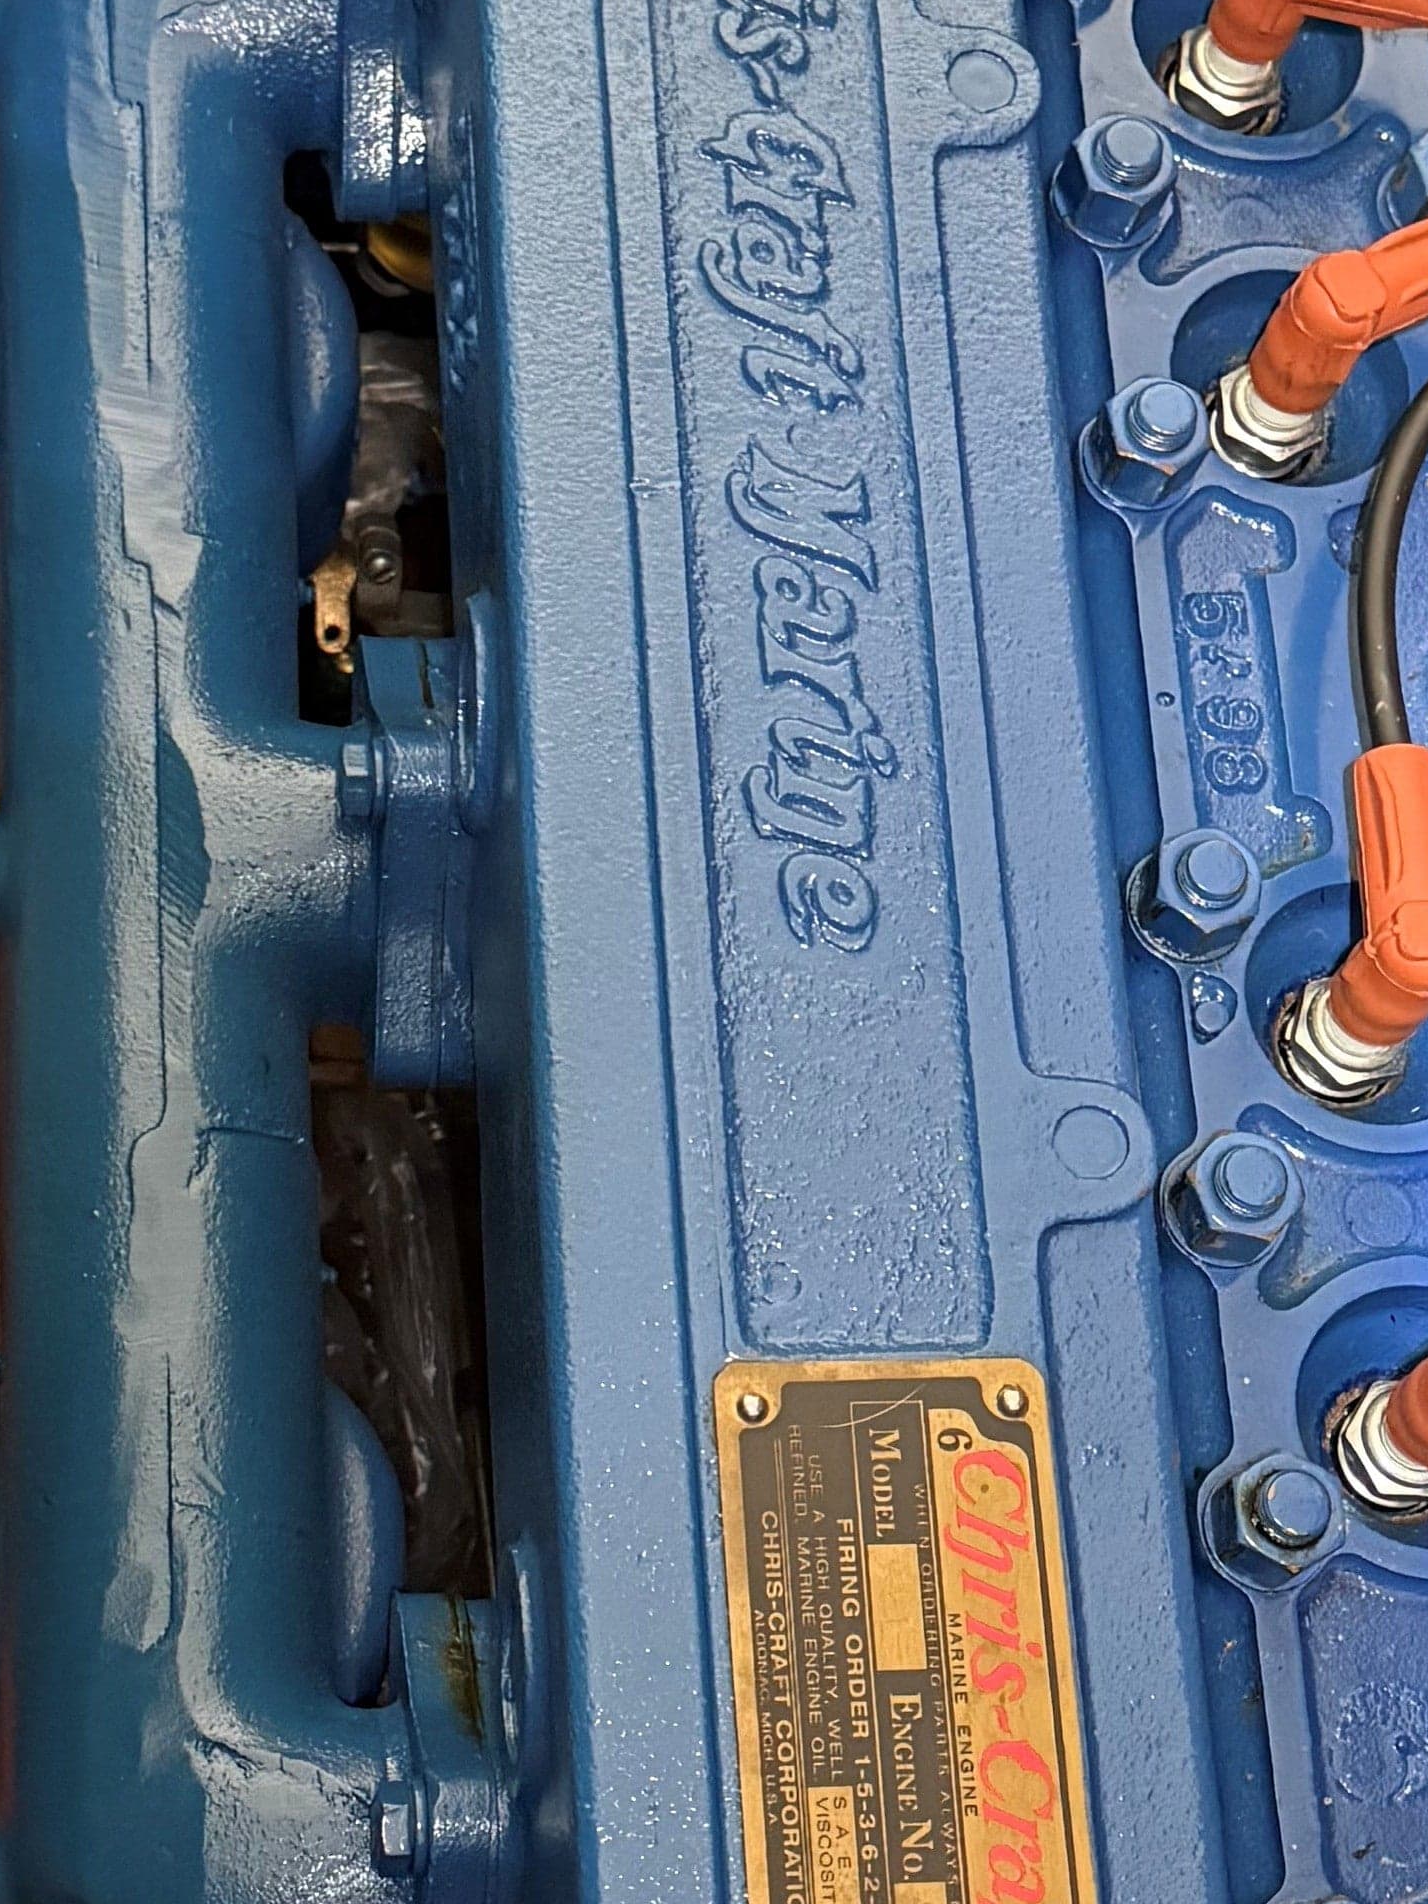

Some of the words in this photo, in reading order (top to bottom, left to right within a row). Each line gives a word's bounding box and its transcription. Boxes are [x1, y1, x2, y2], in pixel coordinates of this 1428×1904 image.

[807, 1453, 824, 1497] USE
[868, 1428, 903, 1539] MODEL
[936, 1427, 973, 1453] 6
[811, 1509, 826, 1524] A
[761, 1510, 792, 1708] CHRIS-CRAFT
[796, 1536, 818, 1628] MARINE
[814, 1536, 831, 1590] HIGH
[835, 1517, 861, 1618] FIRING
[803, 1637, 823, 1725] ENGINE
[844, 1633, 871, 1739] ORDER
[946, 1612, 969, 1705] MARINE
[827, 1718, 845, 1783] WELL
[889, 1692, 924, 1812] ENGINE
[956, 1724, 979, 1818] ENGINE
